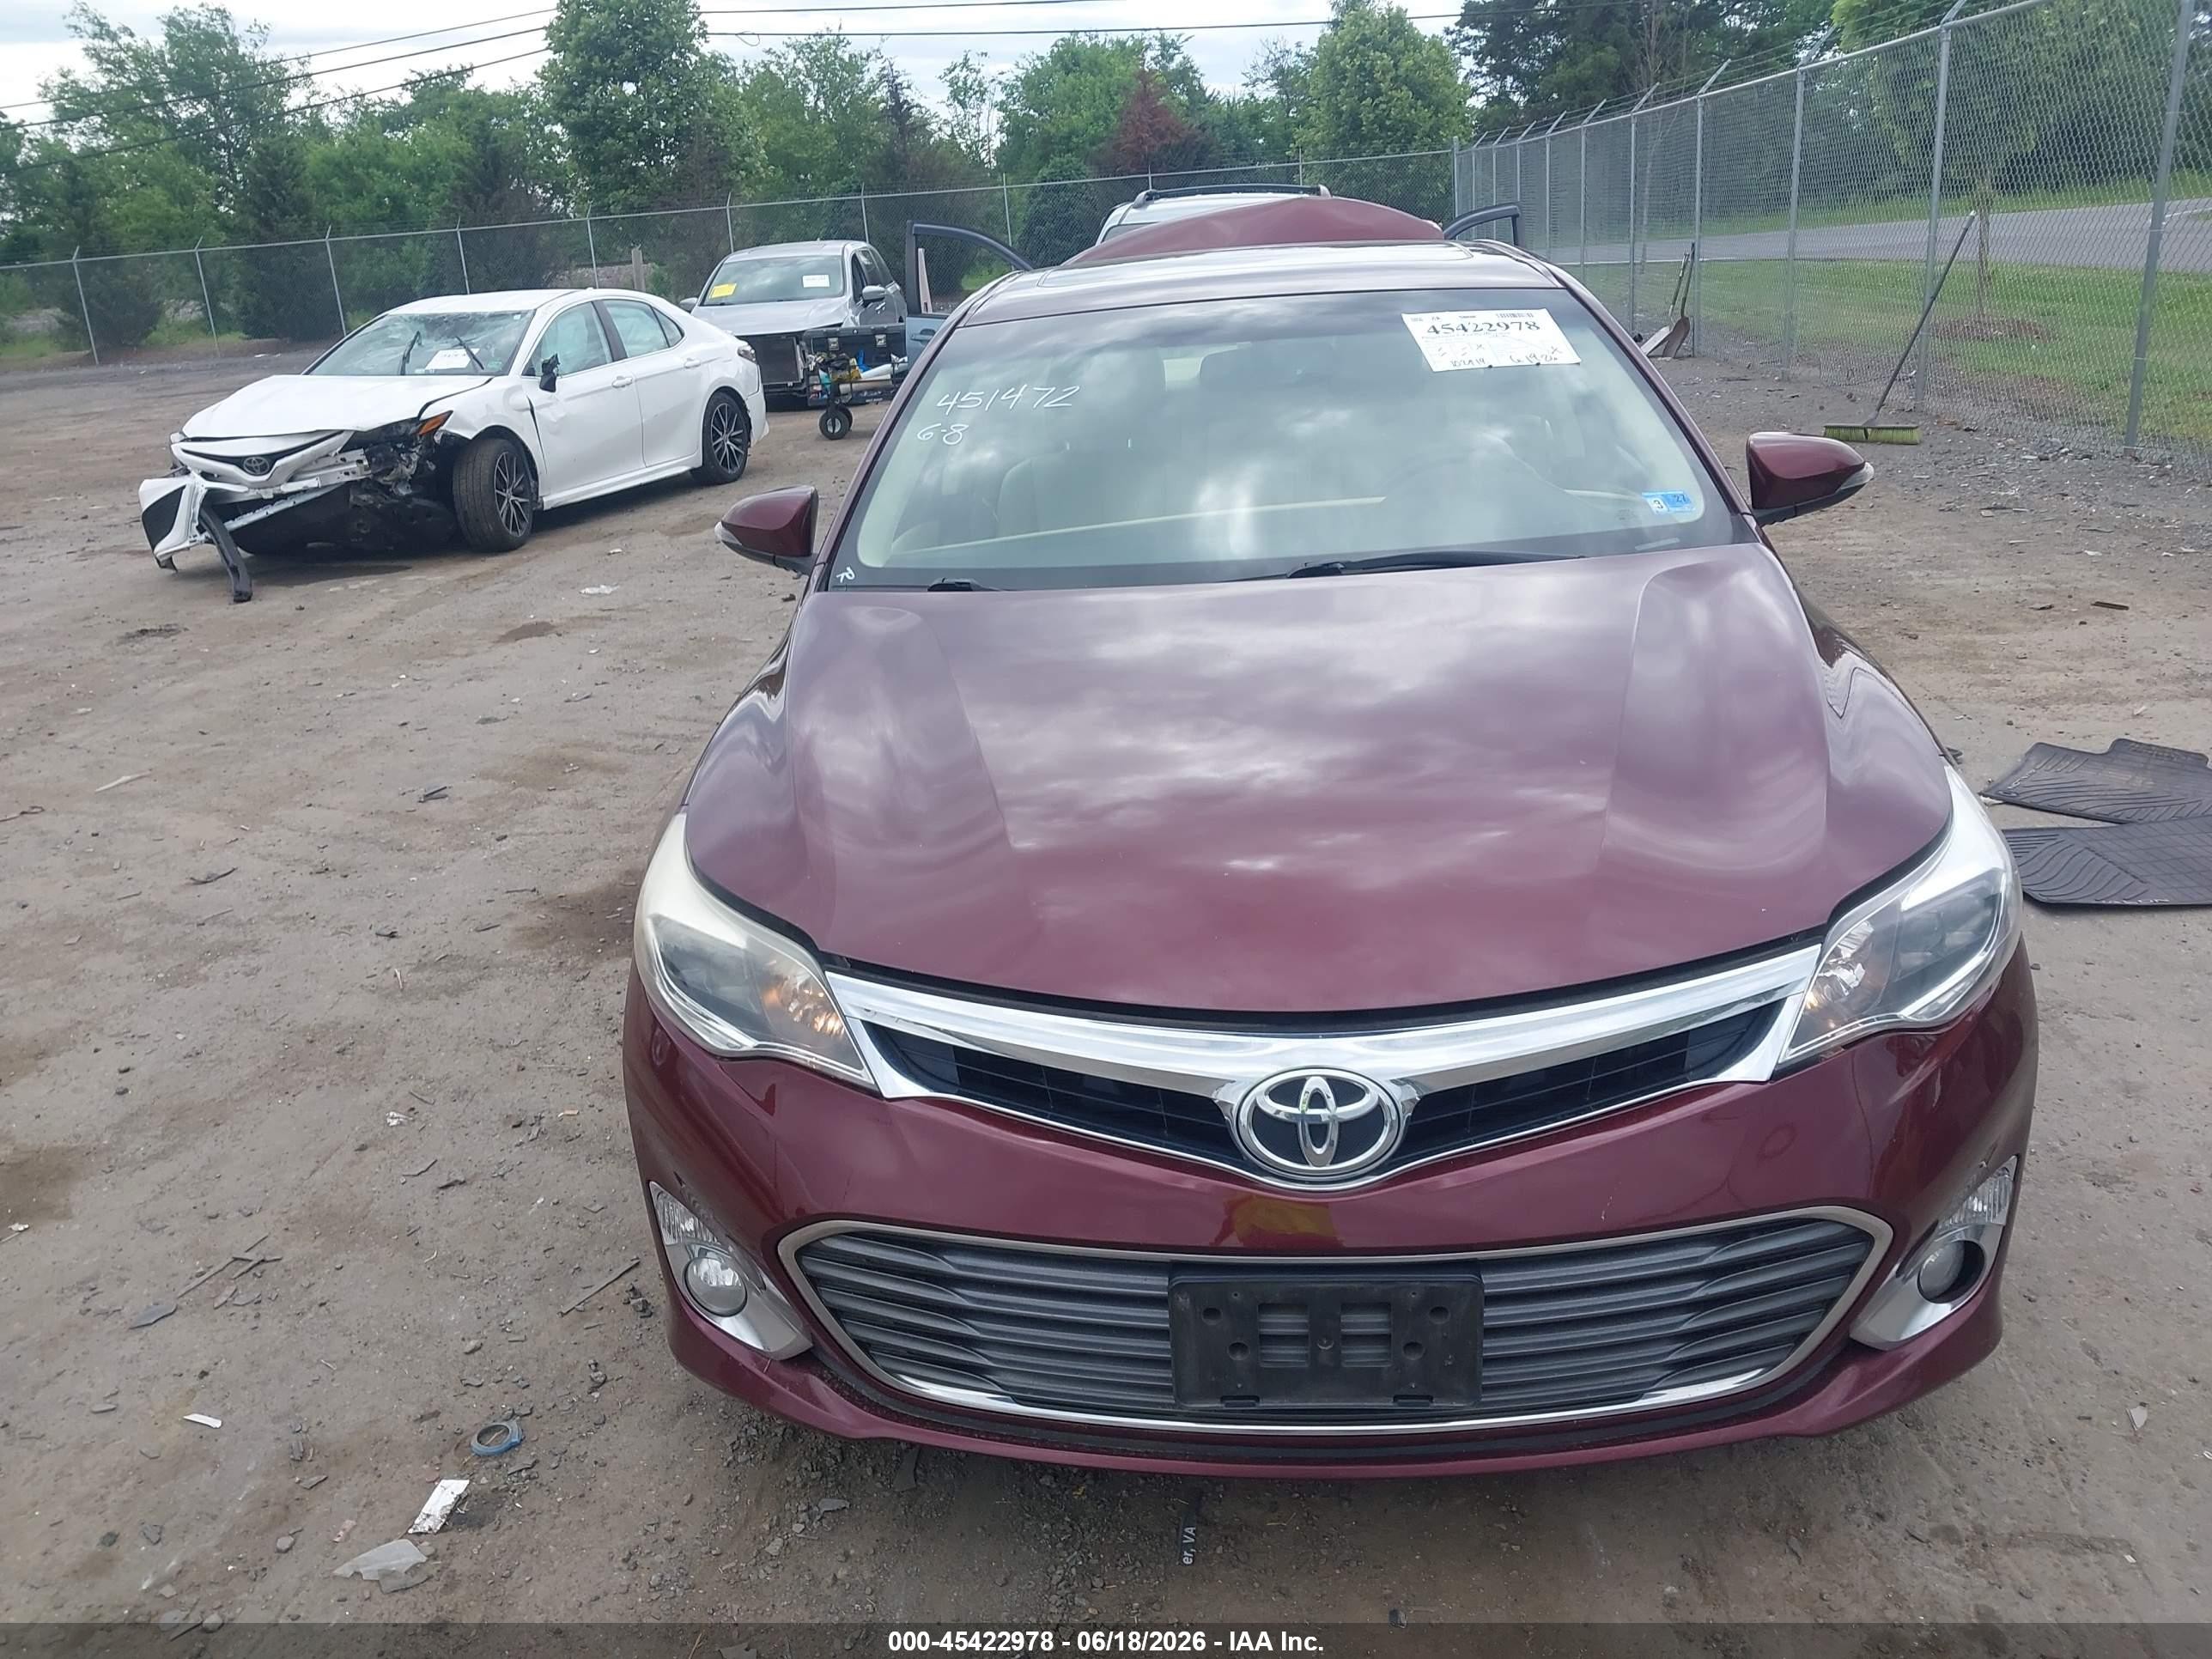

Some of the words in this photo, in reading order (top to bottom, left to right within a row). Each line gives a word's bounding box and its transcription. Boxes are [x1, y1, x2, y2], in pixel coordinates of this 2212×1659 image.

[1426, 321, 1540, 335] 45422978
[936, 384, 1080, 416] 451472
[916, 422, 969, 446] 6-8
[1182, 1527, 1196, 1544] VA
